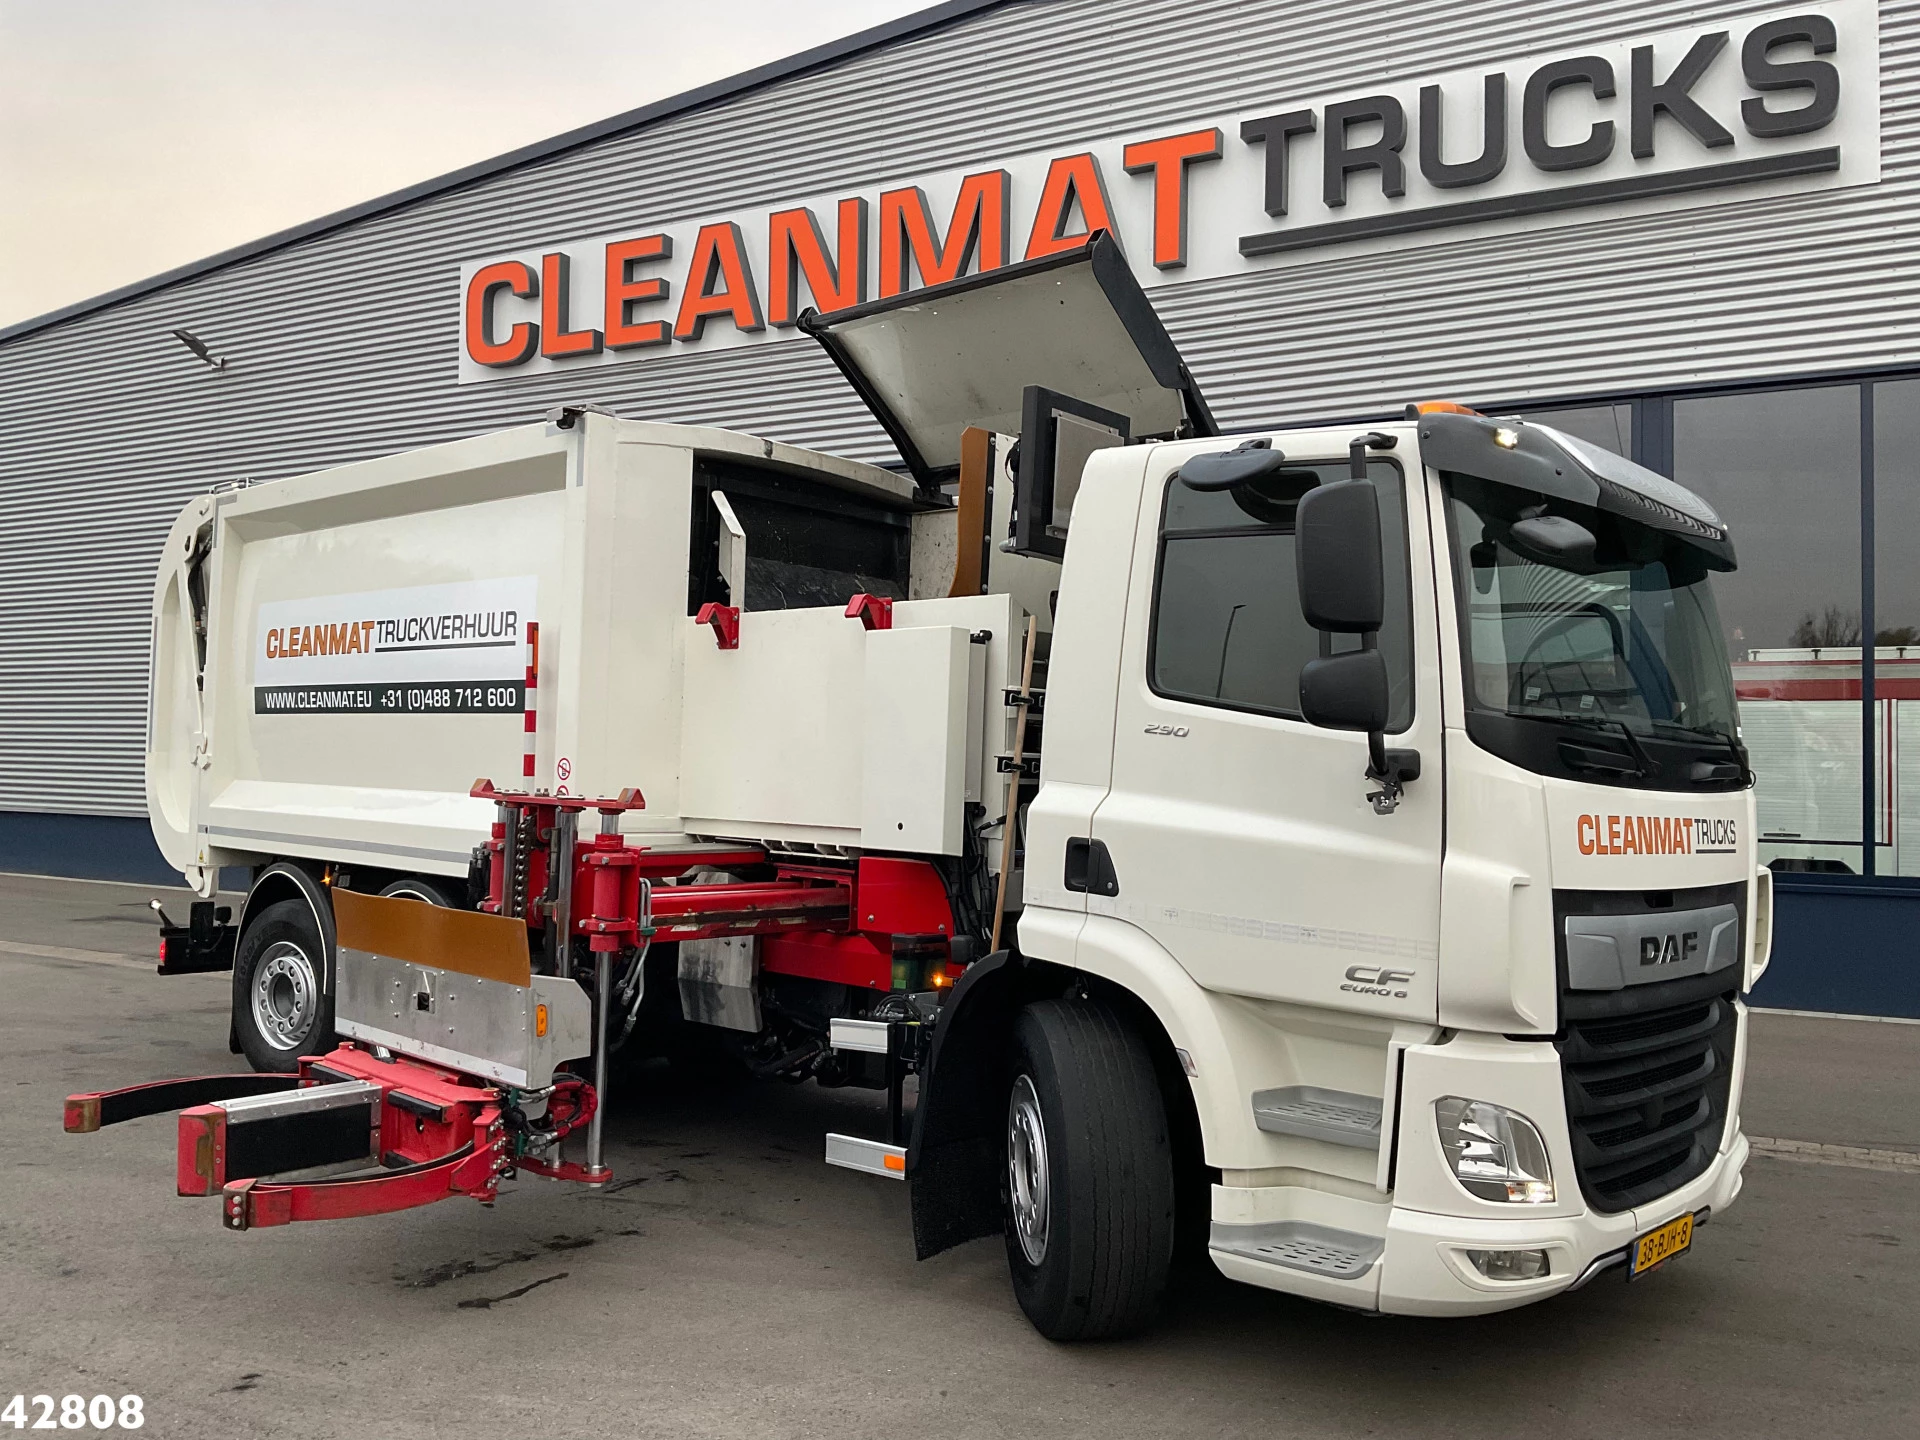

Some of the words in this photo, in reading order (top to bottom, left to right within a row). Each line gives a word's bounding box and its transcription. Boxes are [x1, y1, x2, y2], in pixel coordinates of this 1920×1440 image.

[465, 127, 1225, 369] CLEANMAT
[1240, 14, 1842, 219] TRUCKS
[266, 620, 375, 659] CLEANMAT
[376, 610, 518, 644] TRUCKVERHUUR
[265, 690, 372, 709] WWW.CLEANMAT.EU
[380, 690, 402, 708] +31
[408, 688, 450, 710] (0)488
[455, 688, 483, 708] 712
[487, 687, 516, 708] 600
[1143, 723, 1190, 738] 290
[1577, 814, 1694, 856] CLEANMAT
[1694, 818, 1737, 846] TRUCKS
[1639, 931, 1698, 966] DAF
[1345, 964, 1415, 986] CF
[1340, 983, 1391, 997] EURO
